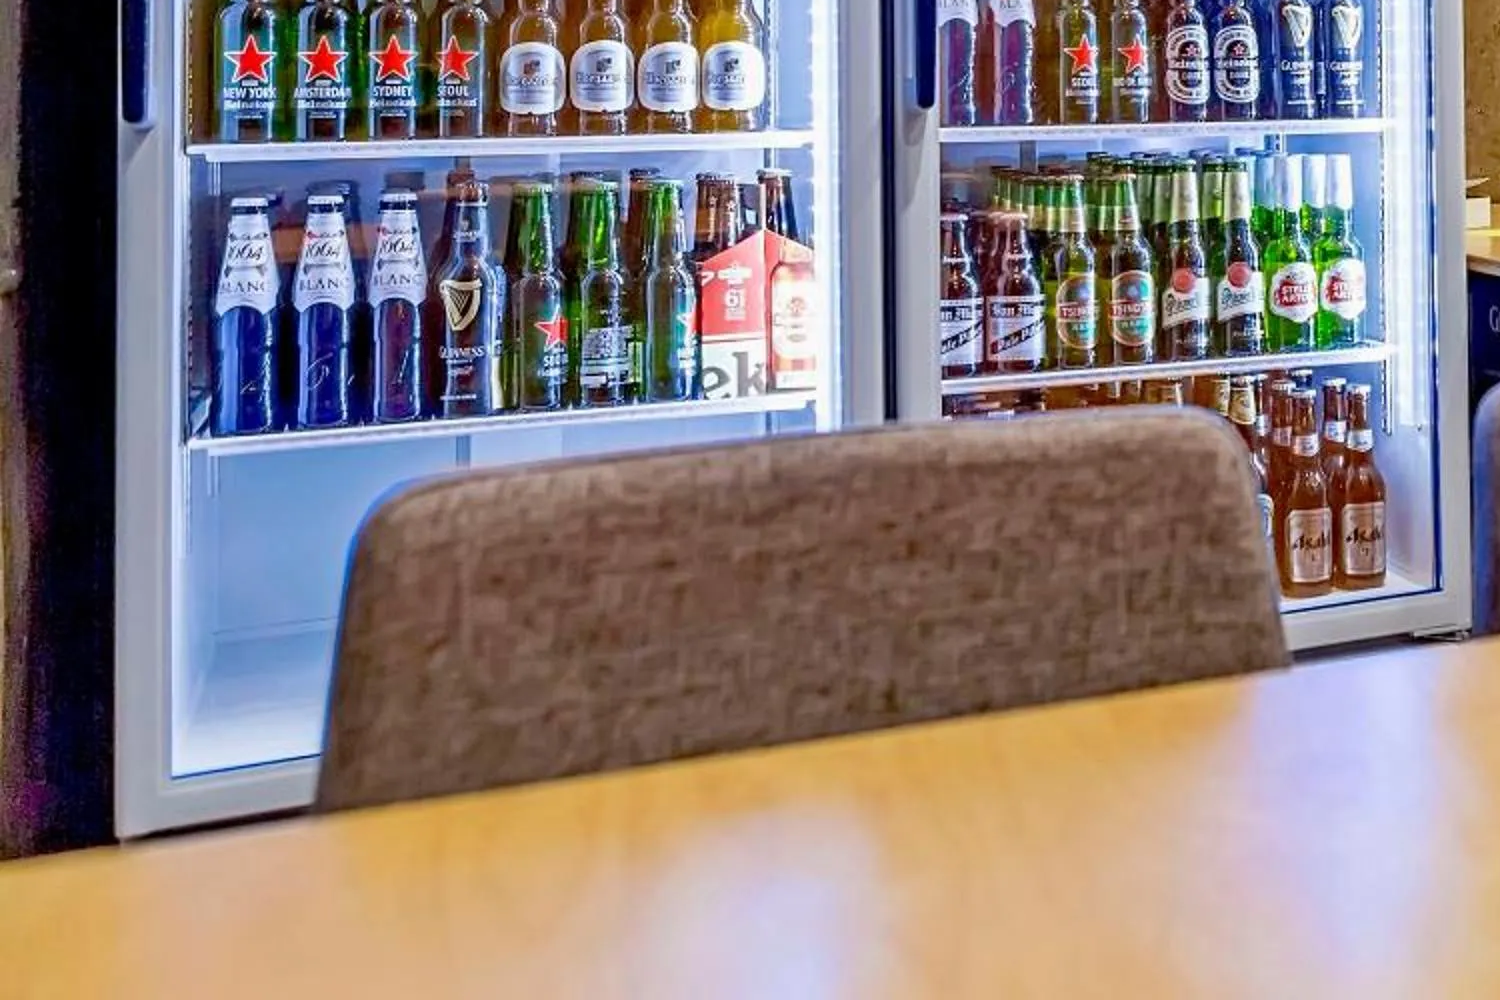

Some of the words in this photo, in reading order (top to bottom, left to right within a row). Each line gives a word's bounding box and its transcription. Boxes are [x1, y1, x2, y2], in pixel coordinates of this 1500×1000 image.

[223, 86, 246, 98] NEW
[248, 86, 277, 98] YORK
[372, 85, 414, 97] SYDNEY
[437, 85, 469, 97] SEOUL
